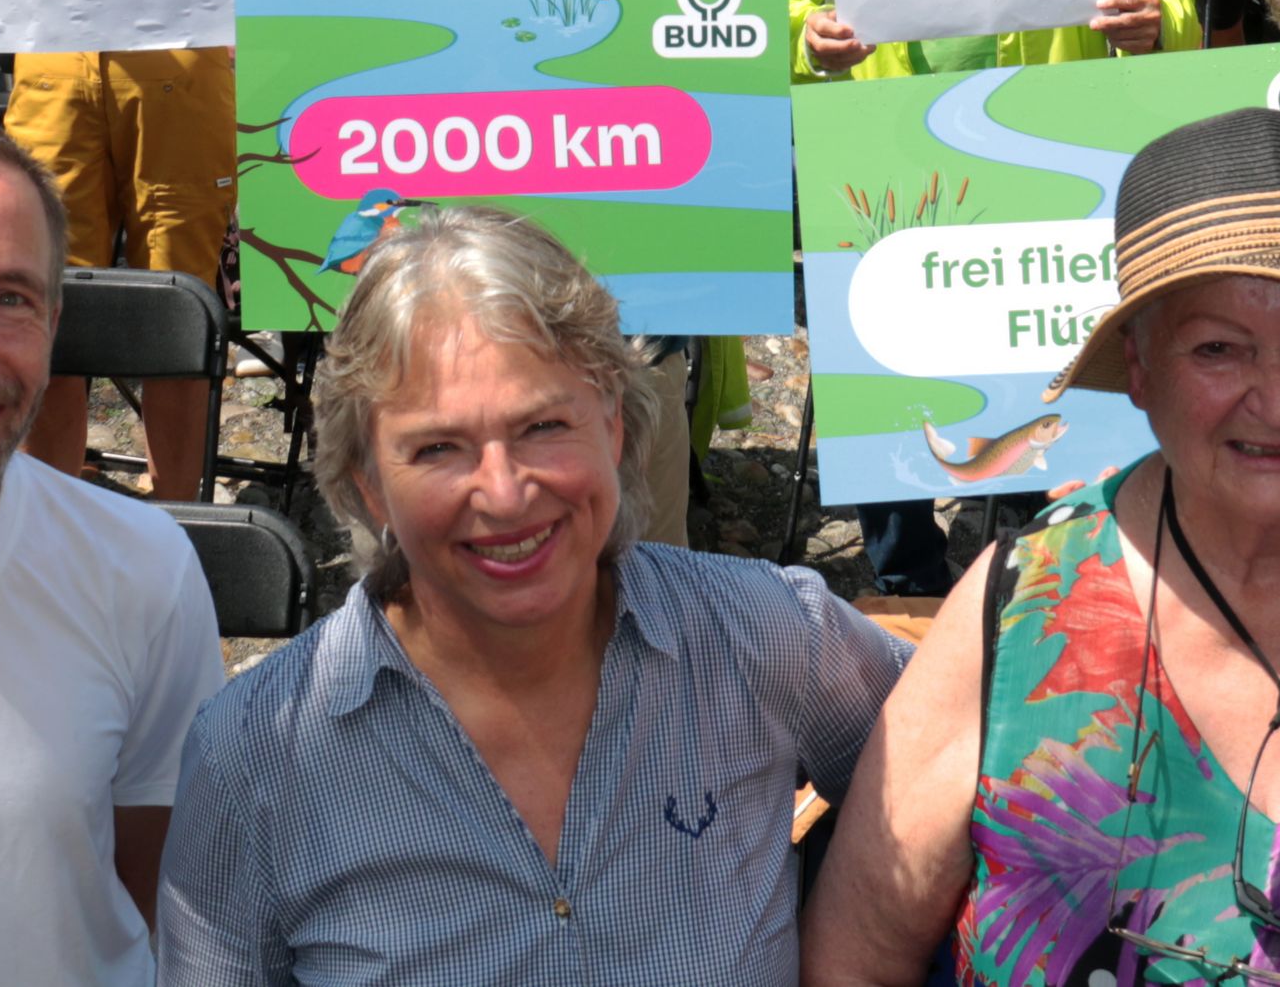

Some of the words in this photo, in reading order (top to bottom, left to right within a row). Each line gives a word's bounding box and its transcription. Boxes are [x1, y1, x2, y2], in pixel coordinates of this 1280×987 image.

[664, 24, 758, 49] BUND
[339, 115, 532, 175] 2000
[552, 114, 662, 169] km
[922, 247, 1004, 288] frei
